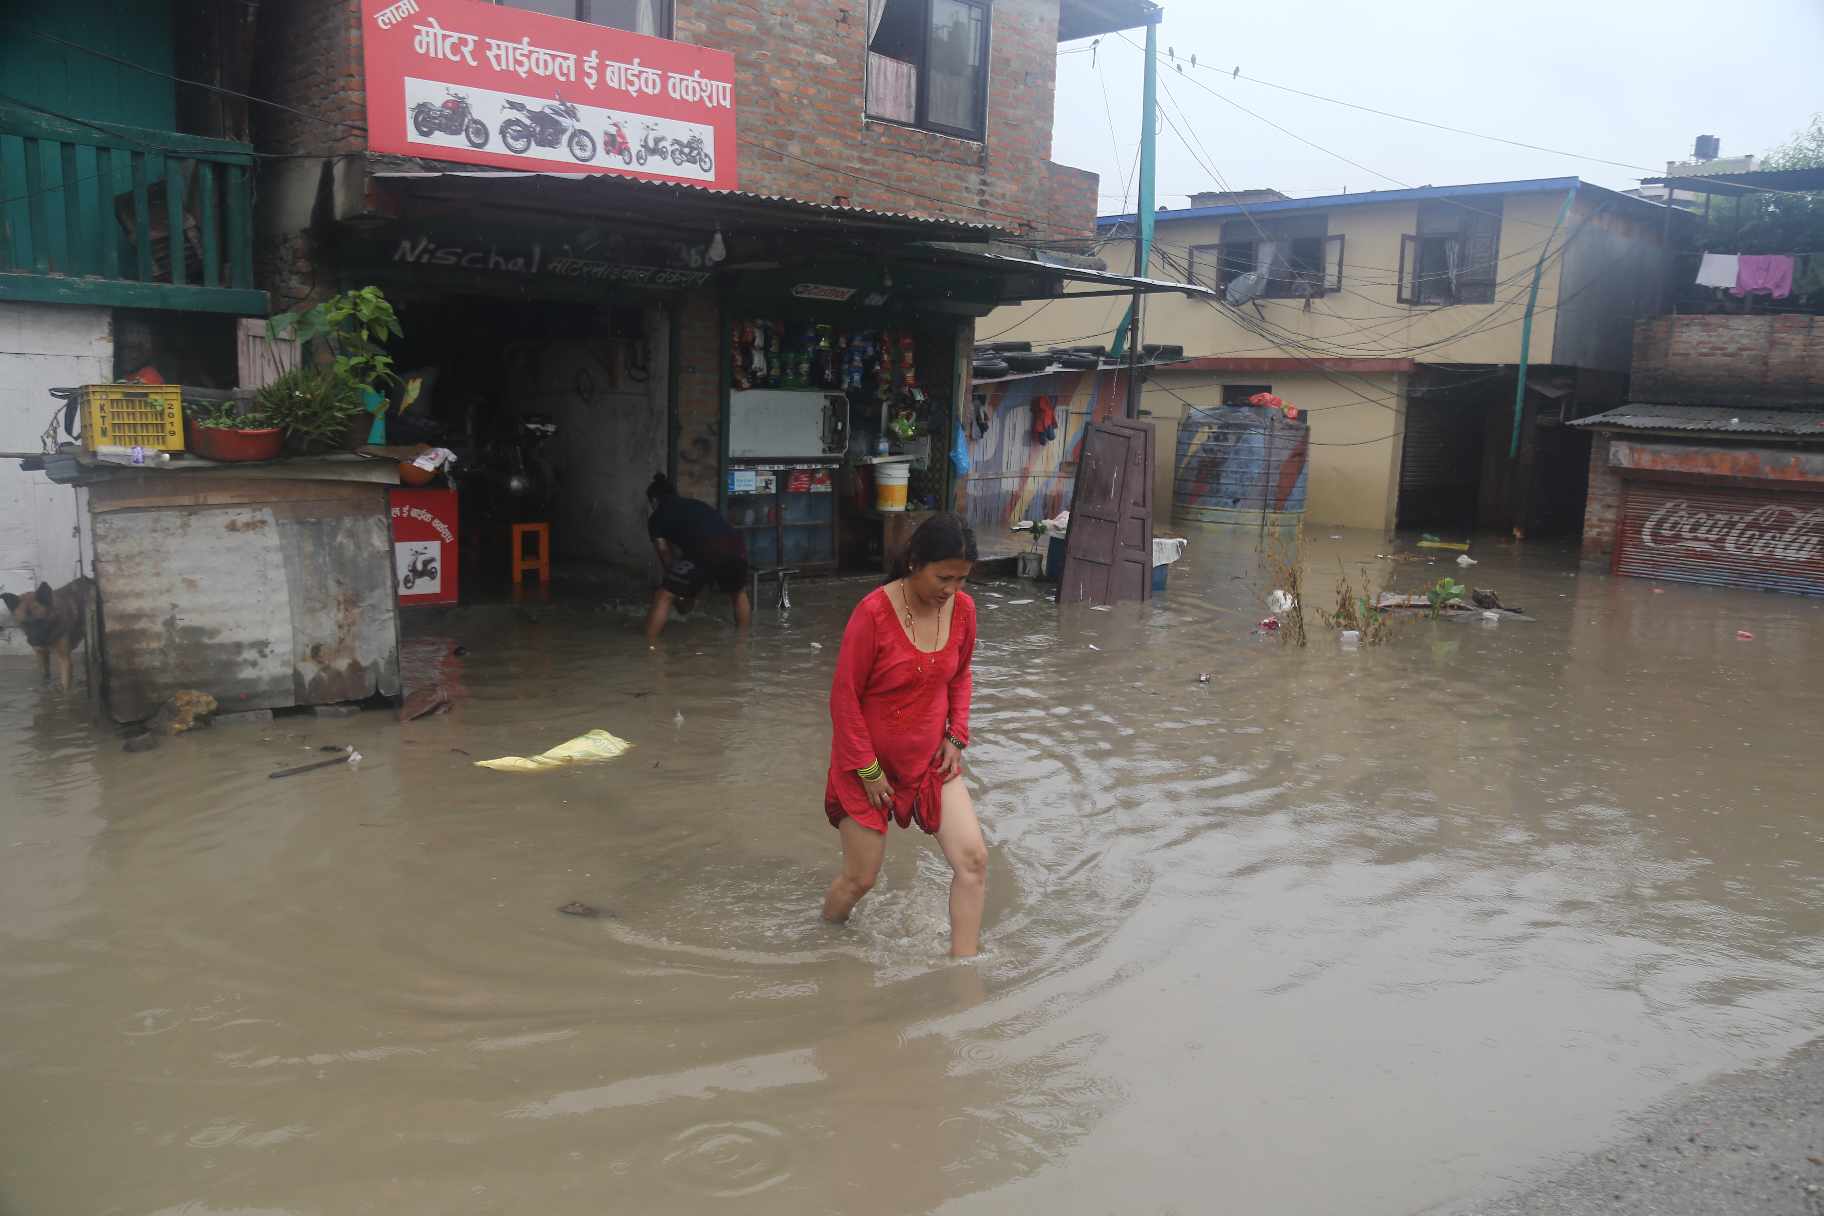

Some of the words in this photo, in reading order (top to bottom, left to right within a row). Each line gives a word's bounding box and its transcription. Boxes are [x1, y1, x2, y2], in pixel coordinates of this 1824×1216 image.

[413, 16, 479, 67] मोटर
[485, 36, 577, 82] साईकल
[583, 49, 600, 90] ई
[605, 57, 662, 98] बाईक
[667, 69, 732, 109] वर्कशप
[392, 236, 541, 273] Nischal
